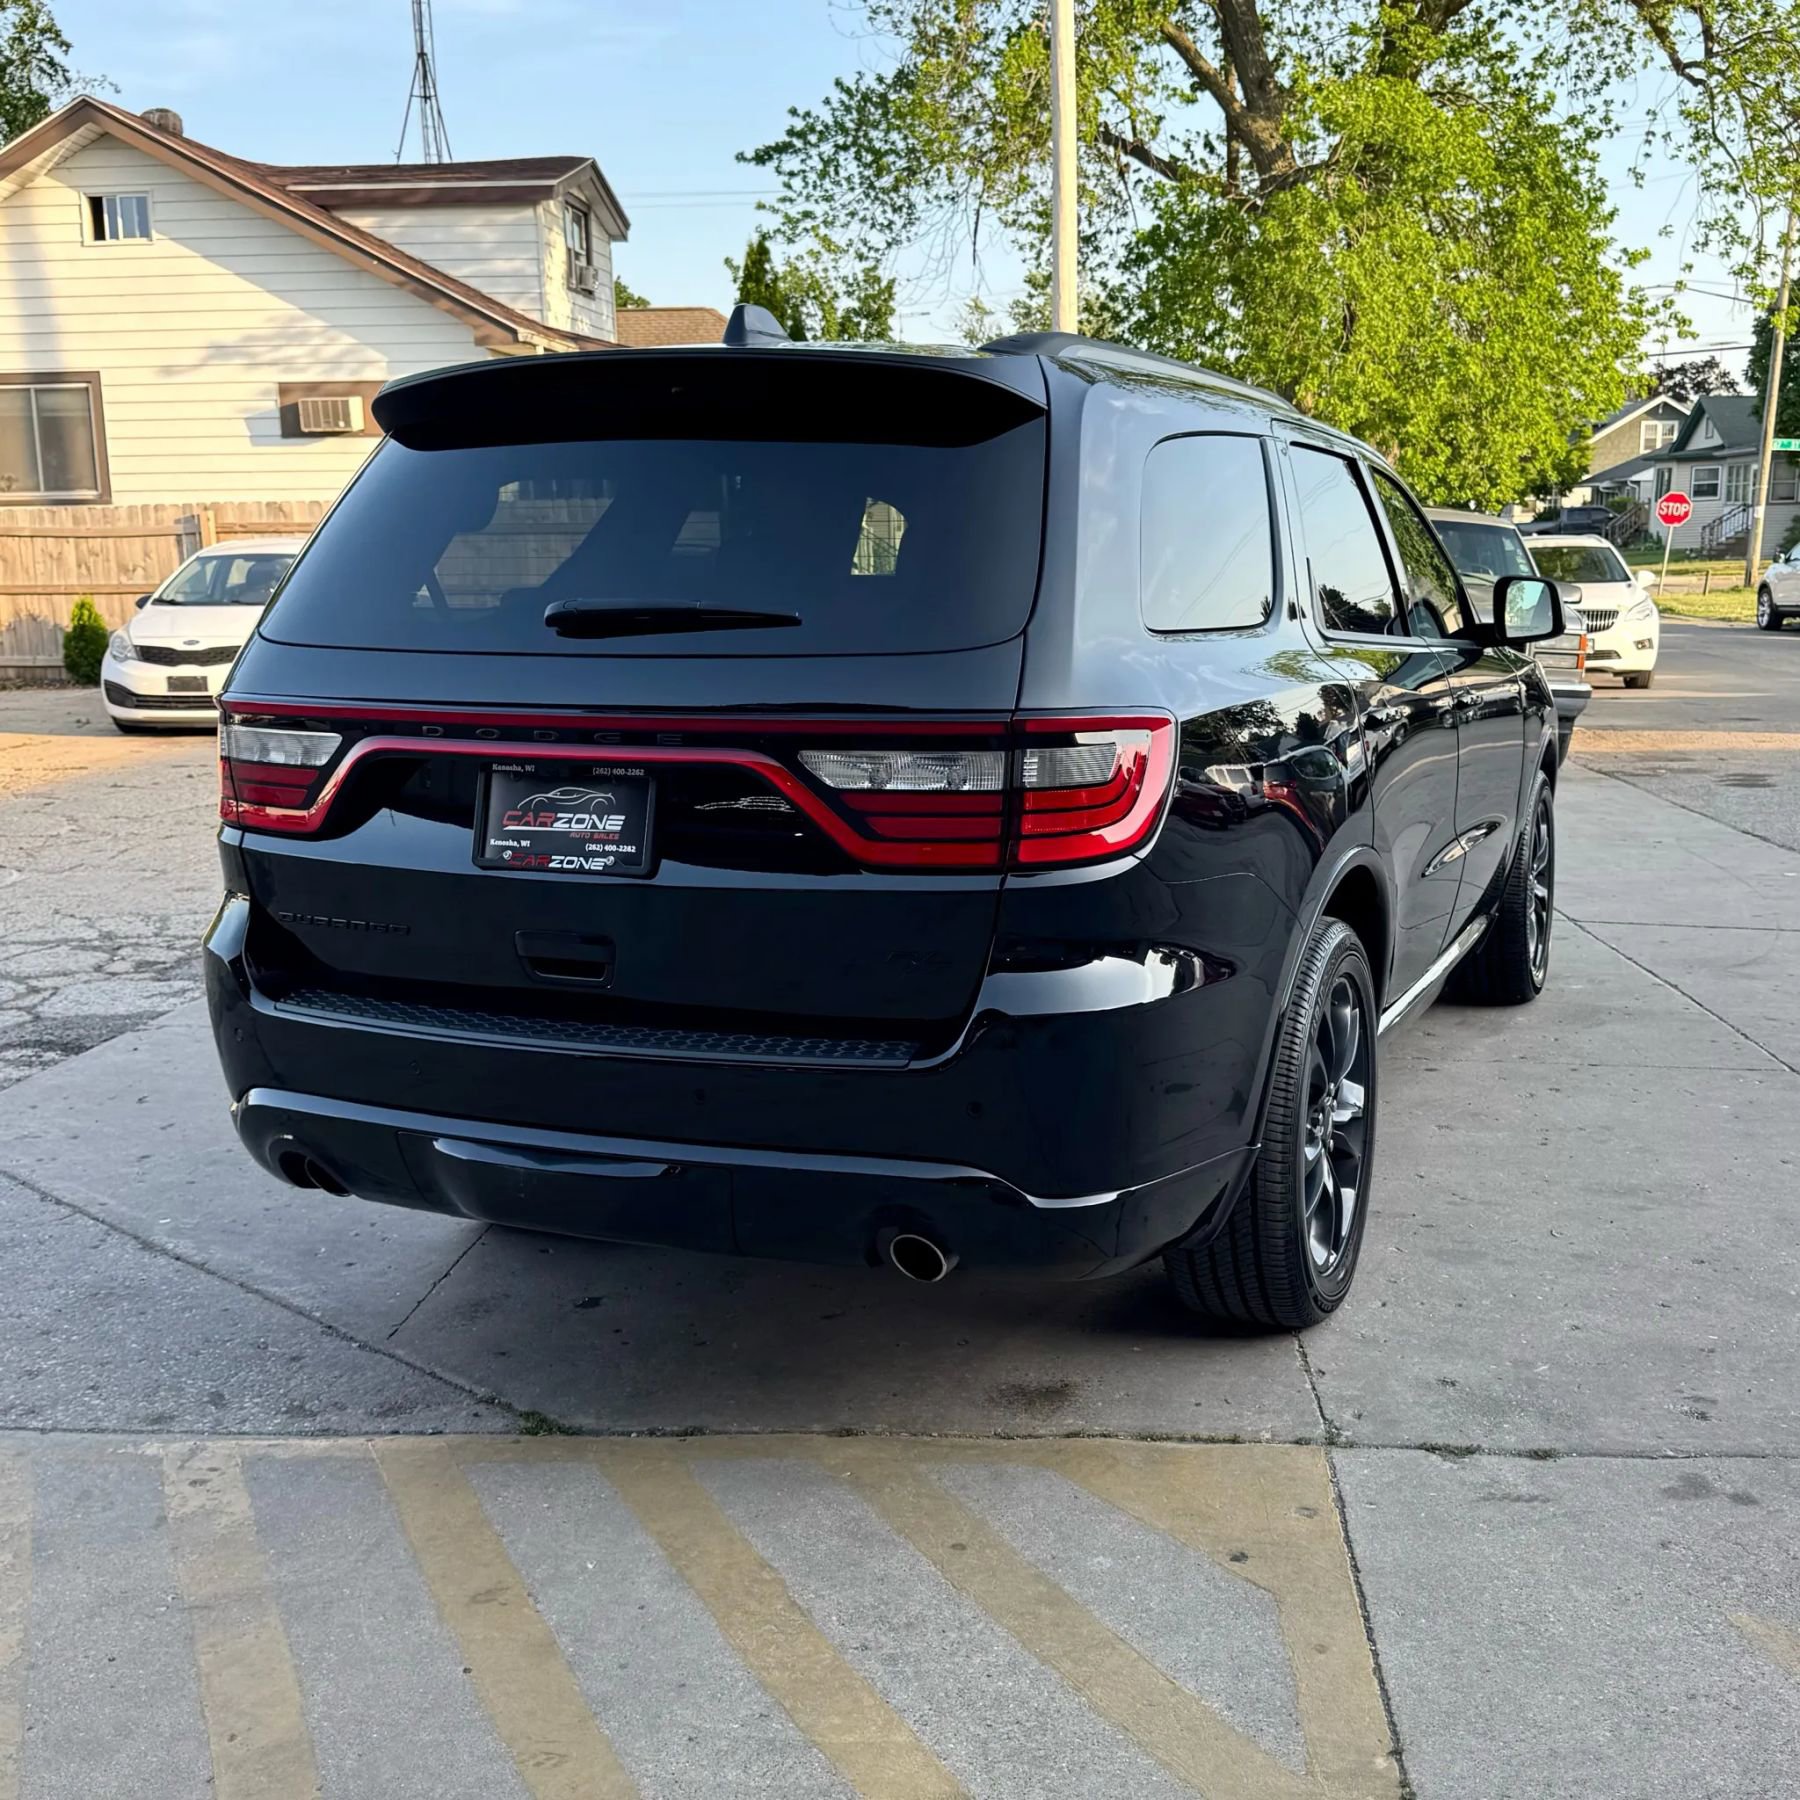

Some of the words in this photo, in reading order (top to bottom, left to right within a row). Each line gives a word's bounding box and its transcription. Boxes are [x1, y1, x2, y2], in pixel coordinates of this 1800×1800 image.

[1659, 502, 1690, 516] STOP
[421, 724, 683, 745] DODGE
[525, 764, 535, 773] WI
[592, 767, 611, 776] (262)
[502, 810, 626, 831] CARZONE
[592, 832, 620, 840] SALES
[490, 838, 519, 848] Kenosha,
[520, 839, 531, 848] WI
[585, 843, 604, 852] (262)
[604, 844, 637, 853] 400-2262
[508, 852, 607, 871] CARZONE
